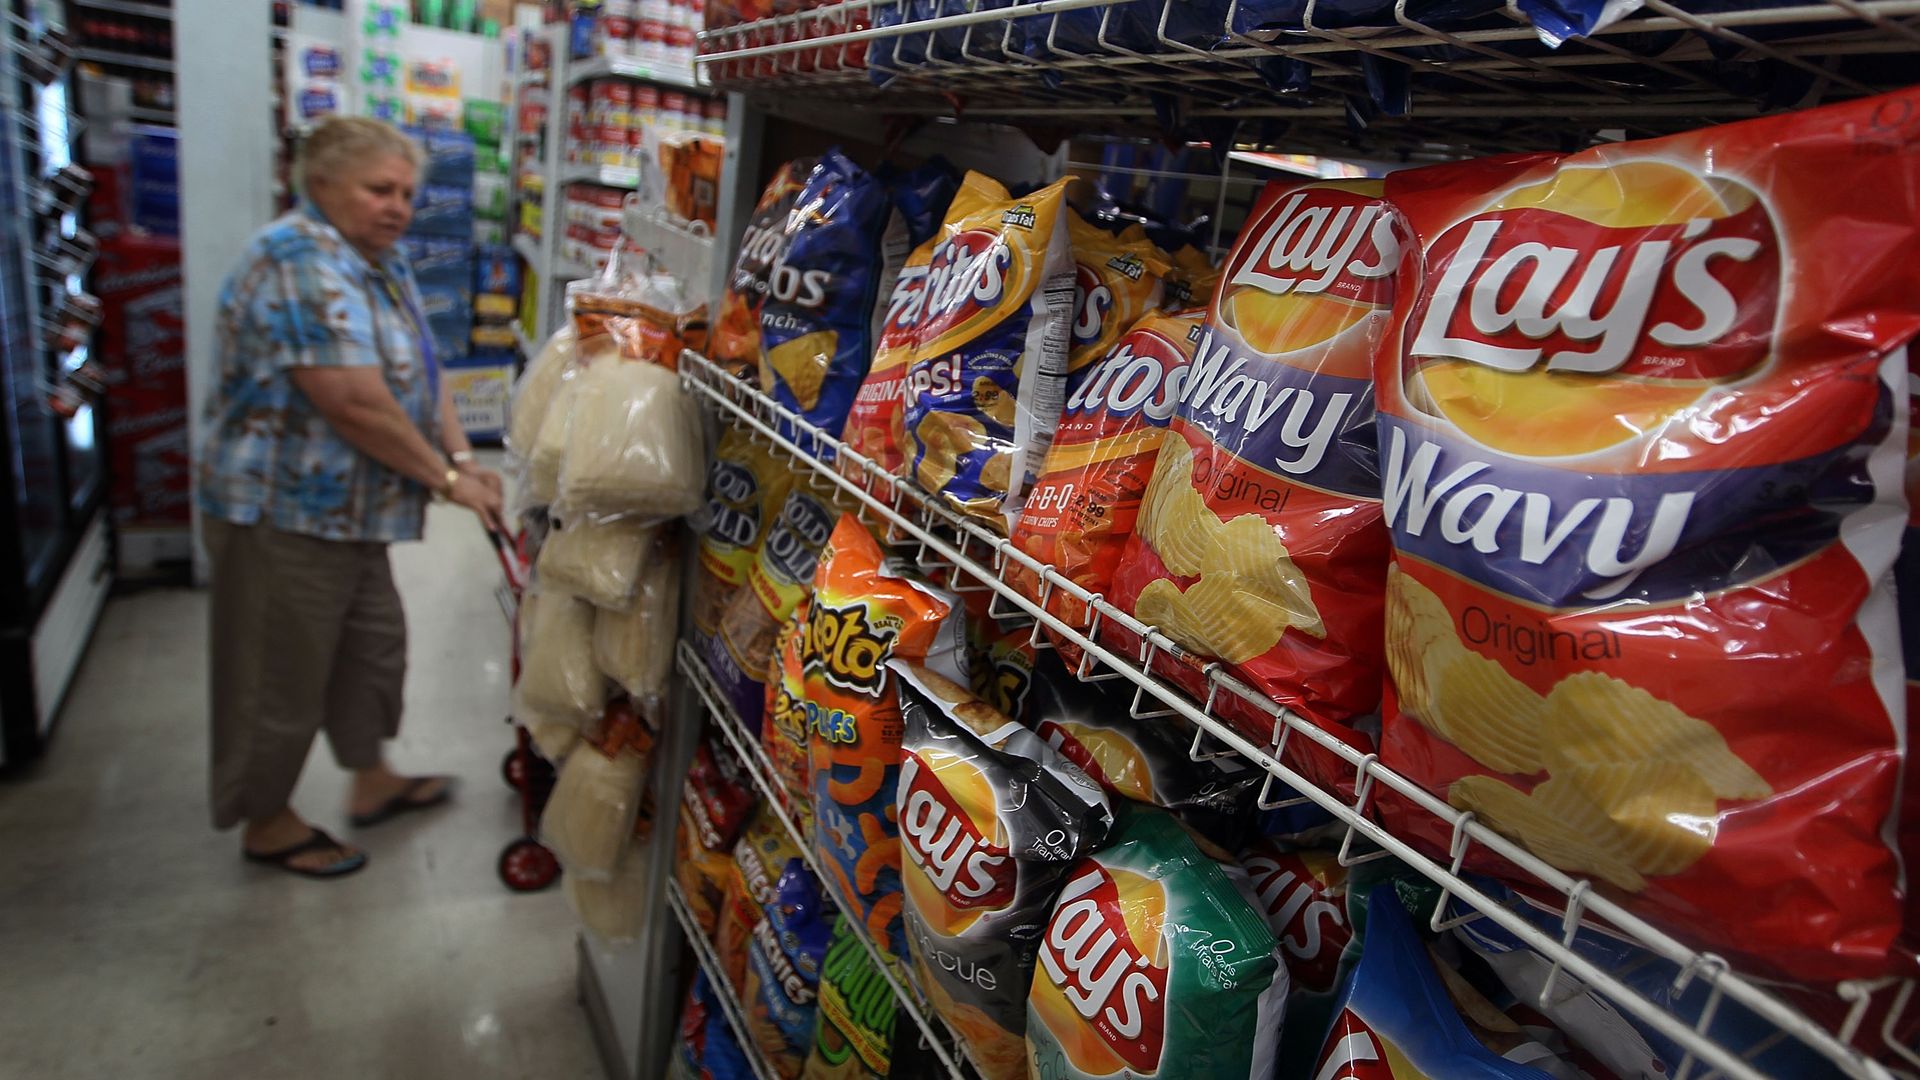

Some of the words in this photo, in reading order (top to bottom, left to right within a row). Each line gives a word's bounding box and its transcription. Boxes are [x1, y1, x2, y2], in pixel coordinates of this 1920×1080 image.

[1410, 217, 1760, 374] Lay's
[1642, 355, 1686, 368] BRAND
[1058, 422, 1094, 431] RAND
[1180, 332, 1351, 474] Wavy
[1075, 494, 1105, 518] 2.99
[1193, 453, 1290, 515] Original
[1384, 426, 1698, 599] Wavy
[1461, 605, 1622, 665] Original
[897, 756, 1005, 898] Lay's
[1044, 829, 1066, 847] 0
[1246, 856, 1343, 959] ay's
[1039, 869, 1159, 1039] Lay's
[1210, 940, 1235, 955] 0
[1098, 1020, 1117, 1042] BRAND
